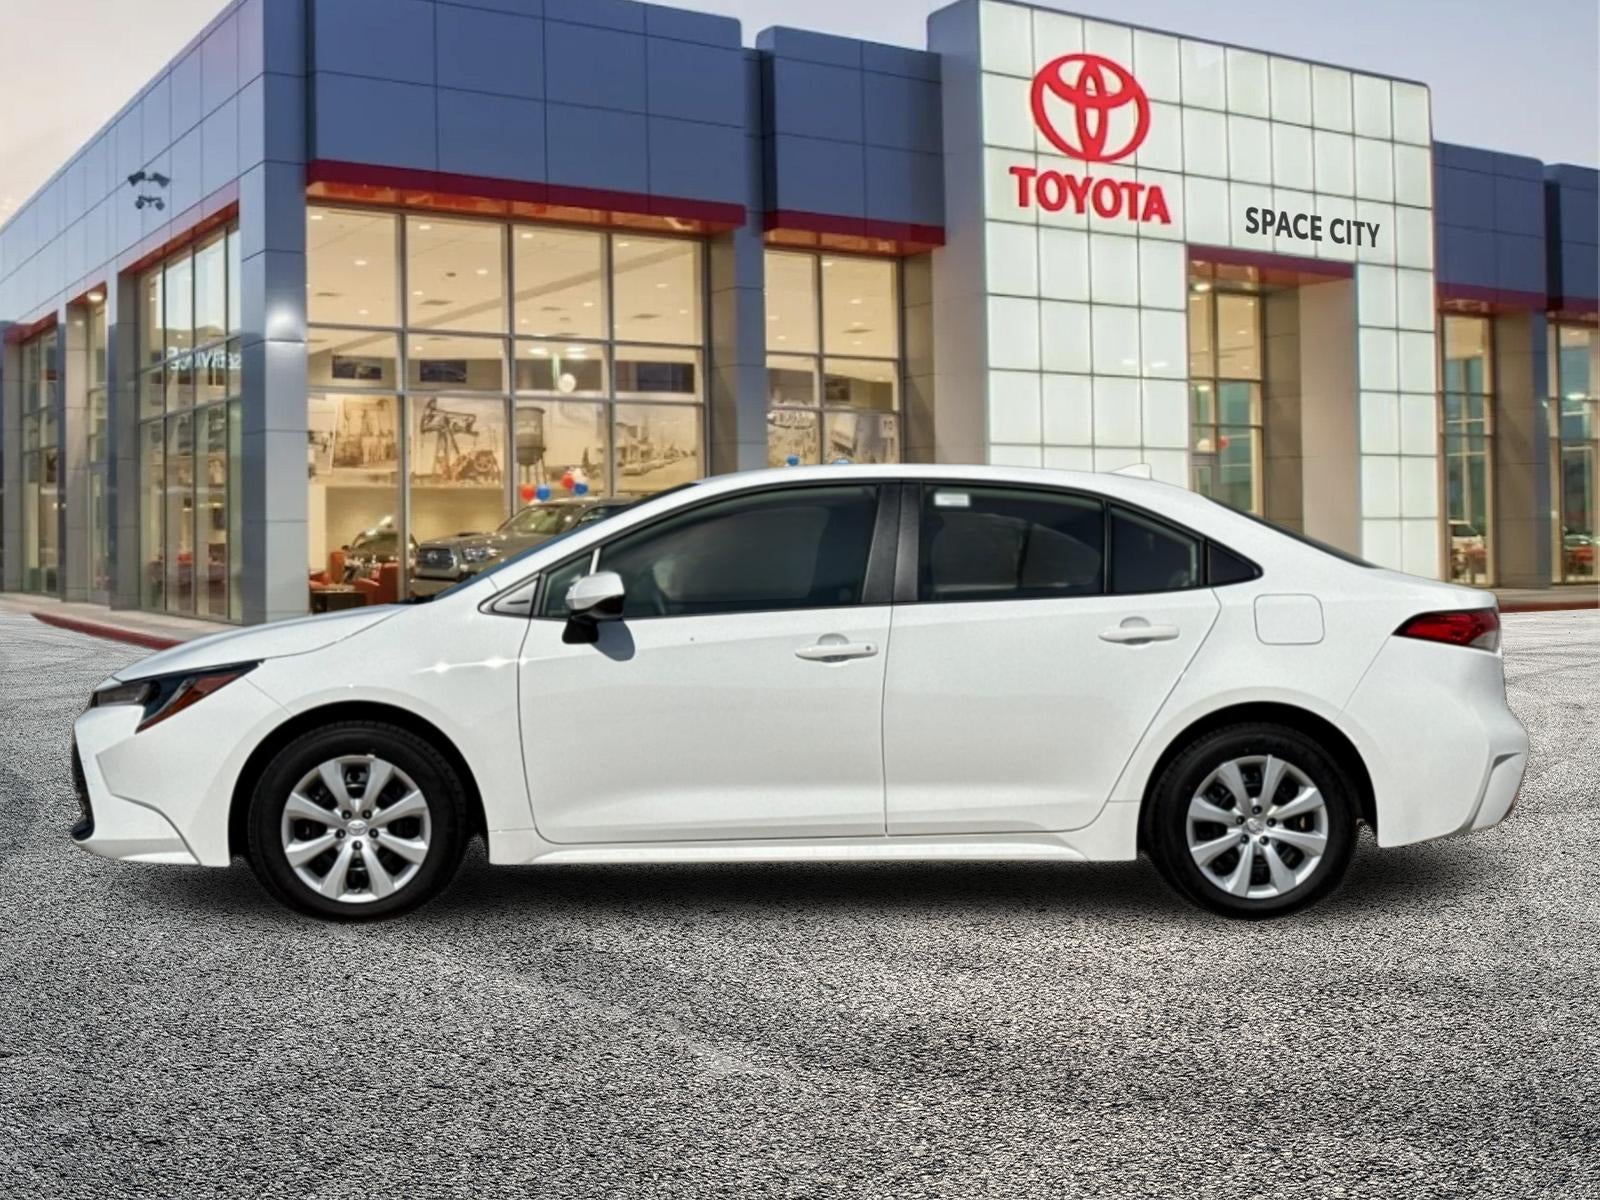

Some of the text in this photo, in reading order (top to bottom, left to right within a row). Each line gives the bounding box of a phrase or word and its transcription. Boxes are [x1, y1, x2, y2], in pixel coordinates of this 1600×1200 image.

[1009, 166, 1171, 224] TOYOTA
[1245, 206, 1381, 248] SPACE CITY
